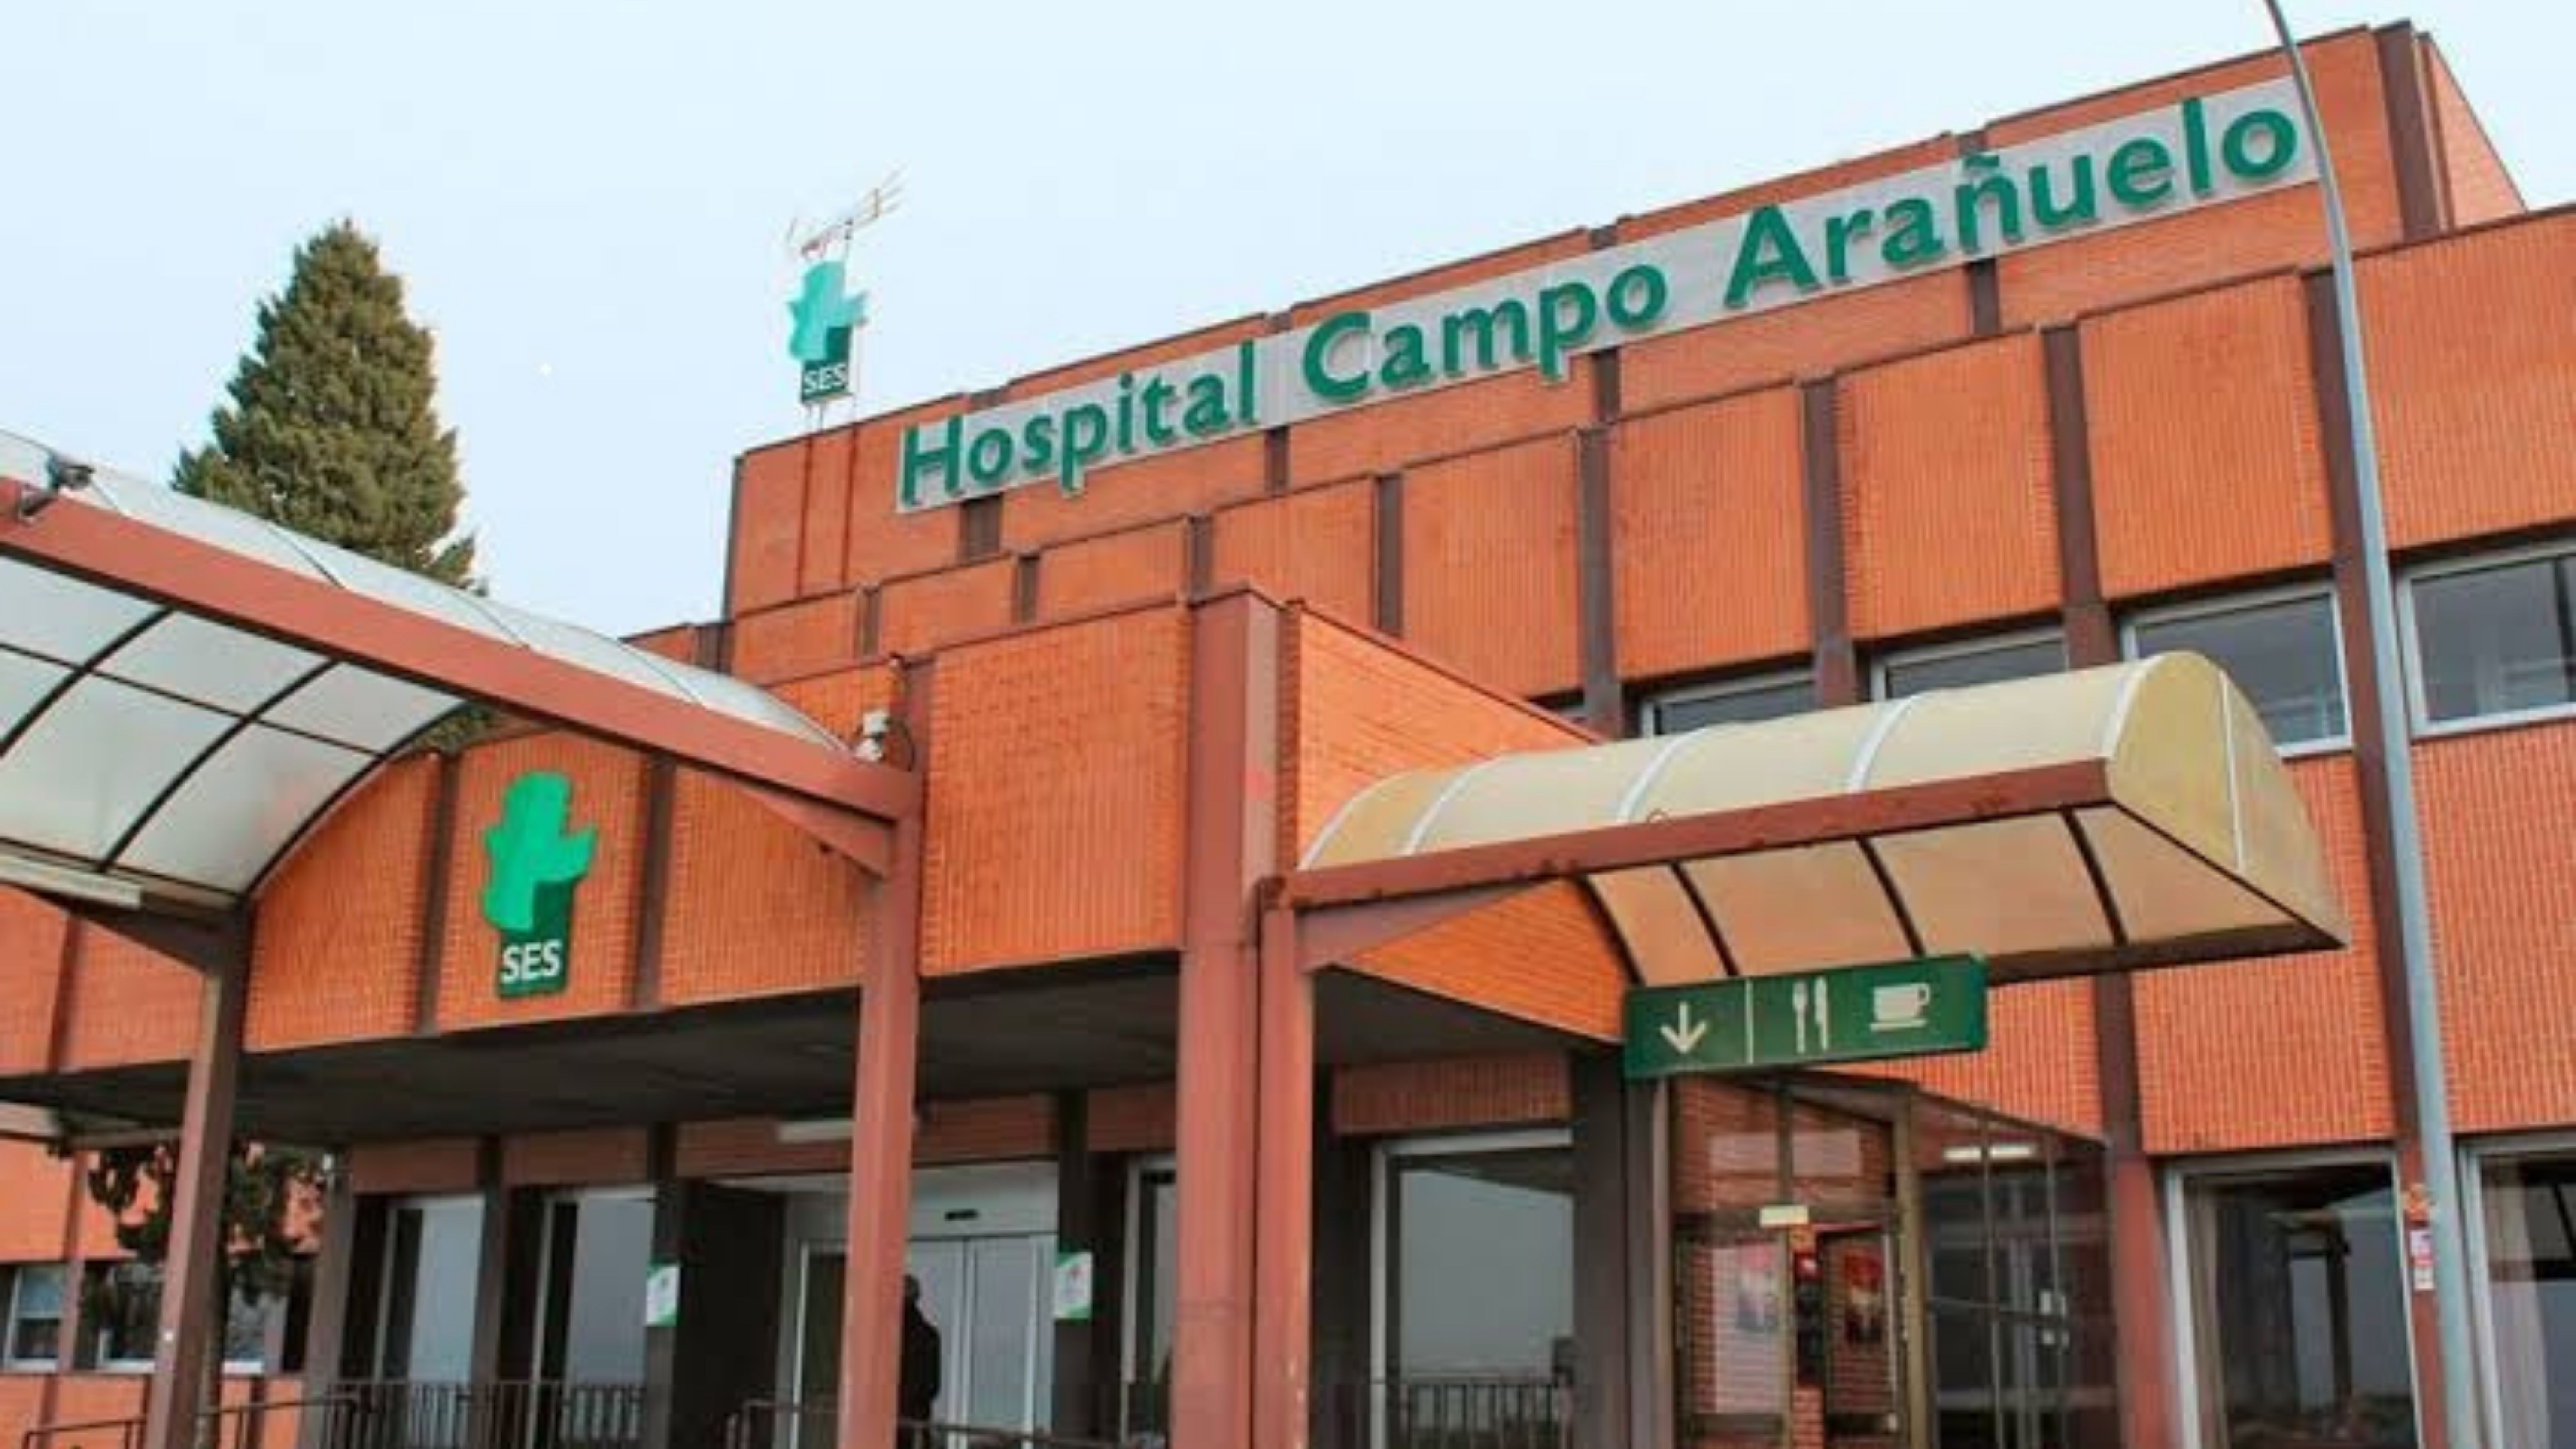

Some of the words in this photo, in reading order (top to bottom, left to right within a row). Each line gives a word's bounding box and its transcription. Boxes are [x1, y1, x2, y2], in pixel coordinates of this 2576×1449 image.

[901, 339, 1257, 505] Hospital
[1302, 264, 1668, 401] Campo
[1723, 97, 2297, 307] Arañuelo
[804, 363, 848, 394] SES
[500, 939, 562, 983] SES
